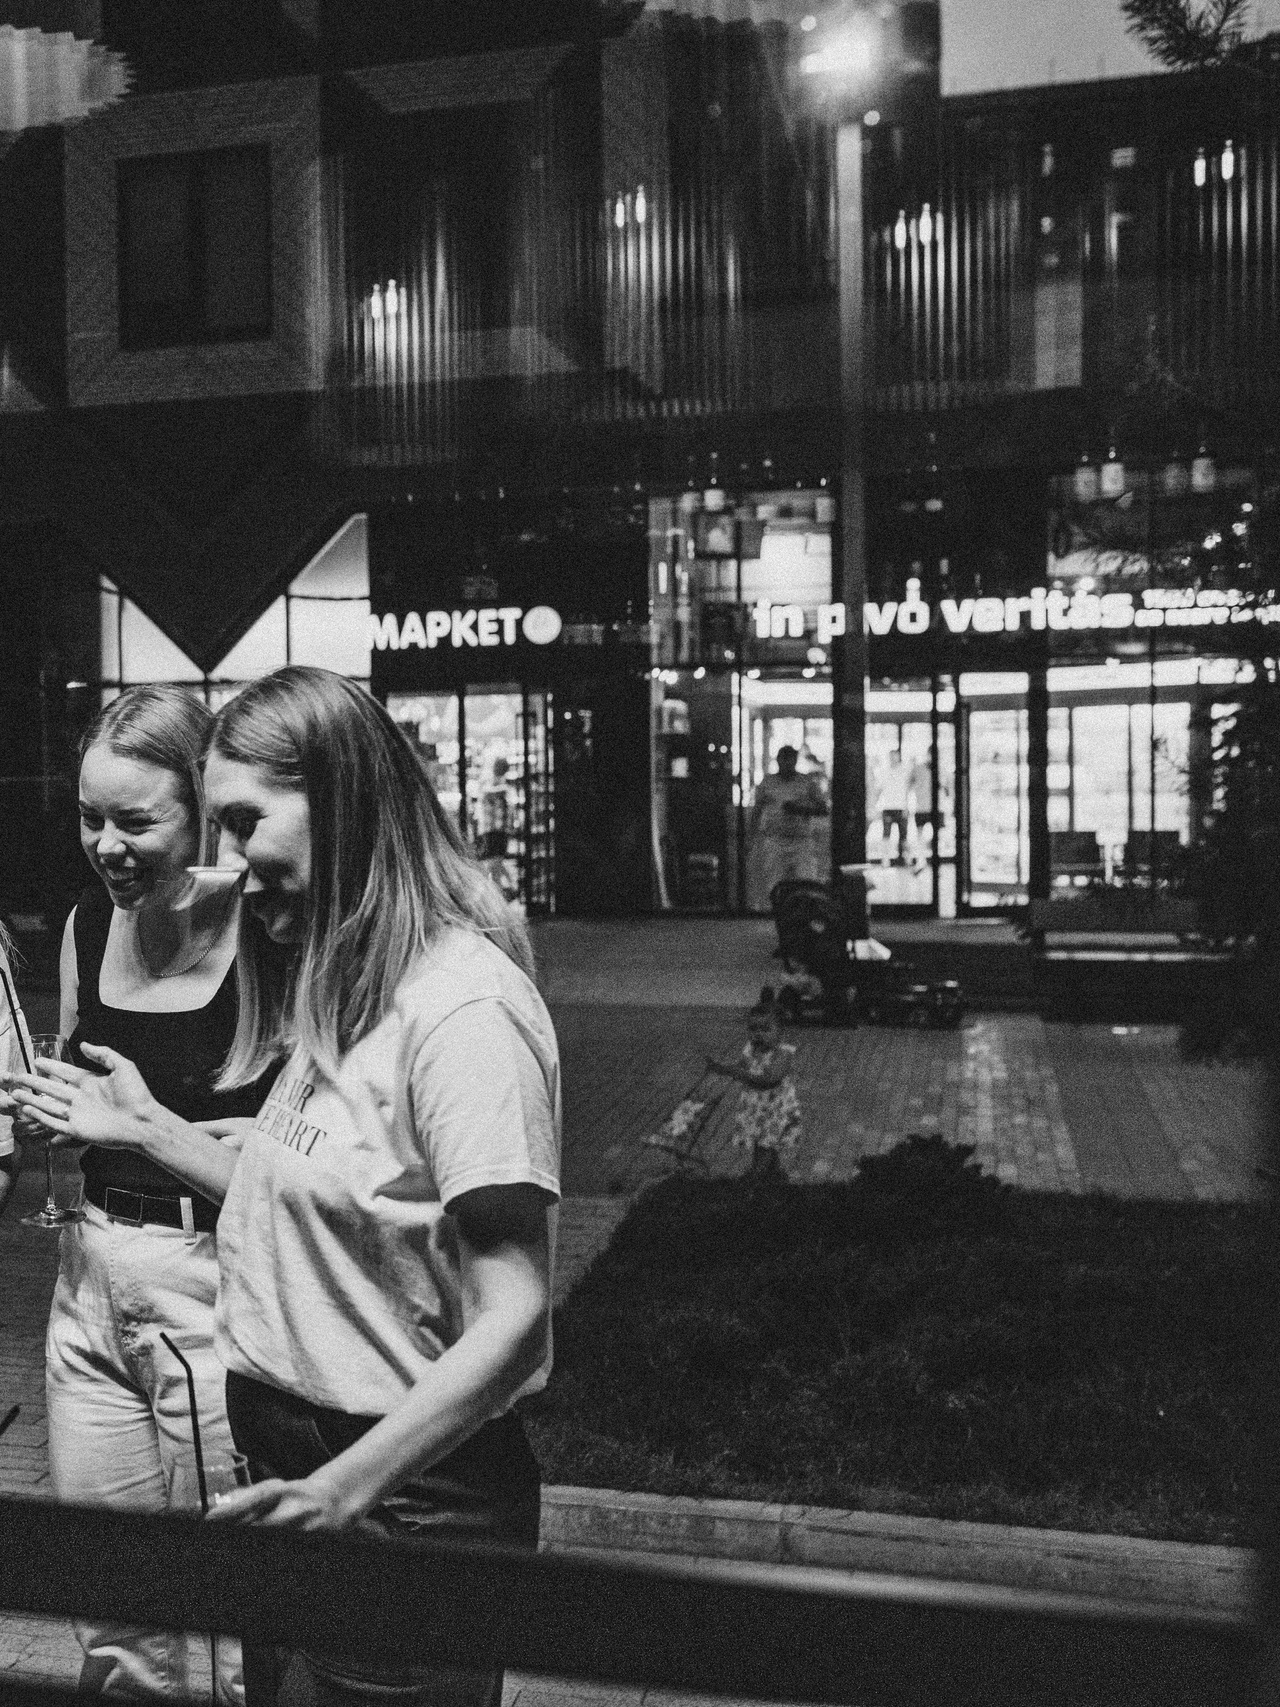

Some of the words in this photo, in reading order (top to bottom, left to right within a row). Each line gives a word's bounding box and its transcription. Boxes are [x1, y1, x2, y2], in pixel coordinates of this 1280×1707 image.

[367, 606, 522, 650] МАРКЕТ
[817, 602, 930, 644] pvo
[940, 587, 1135, 632] veritas
